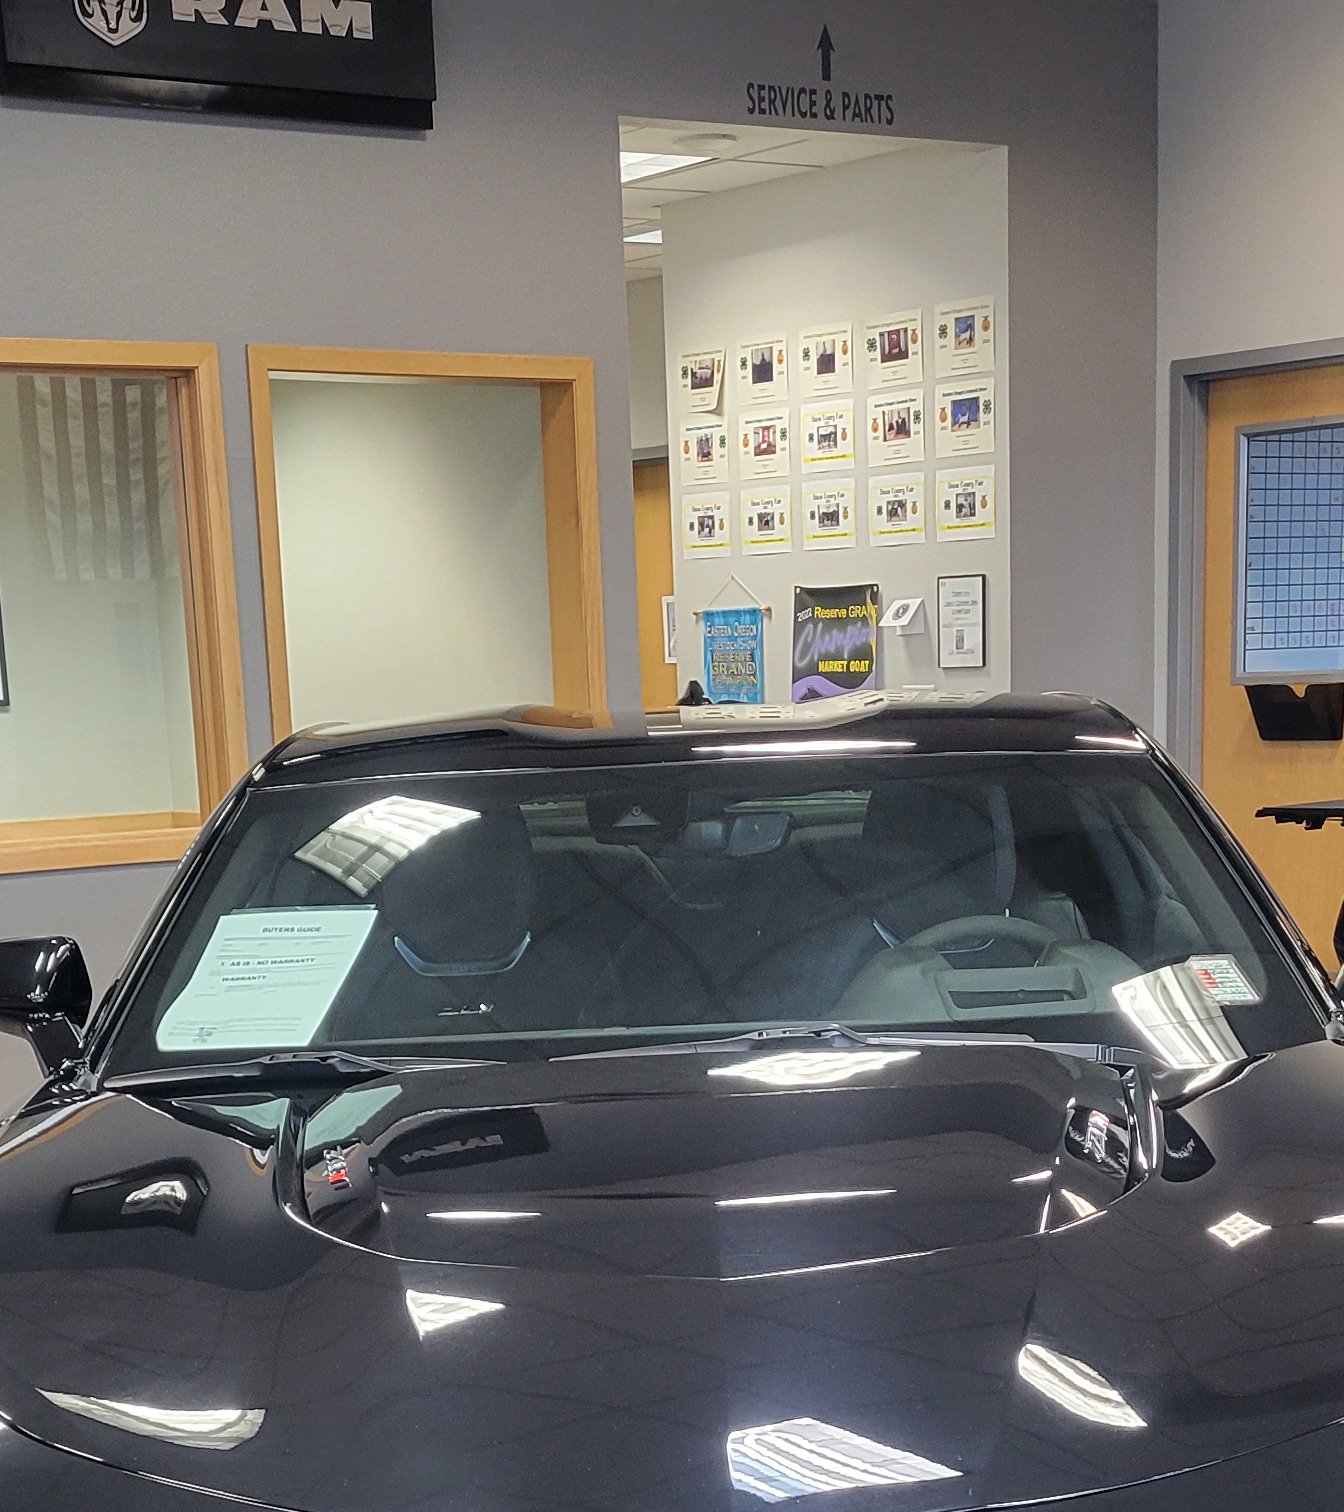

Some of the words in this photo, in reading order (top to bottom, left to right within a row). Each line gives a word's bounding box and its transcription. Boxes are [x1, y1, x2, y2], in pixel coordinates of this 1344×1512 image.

[170, 0, 374, 40] RAM
[746, 82, 818, 119] SERVICE
[823, 89, 836, 121] &
[841, 91, 895, 126] PARTS
[814, 606, 847, 618] Reserve
[712, 662, 756, 675] GRAND
[818, 660, 848, 673] MARKET
[849, 660, 870, 673] GOAT
